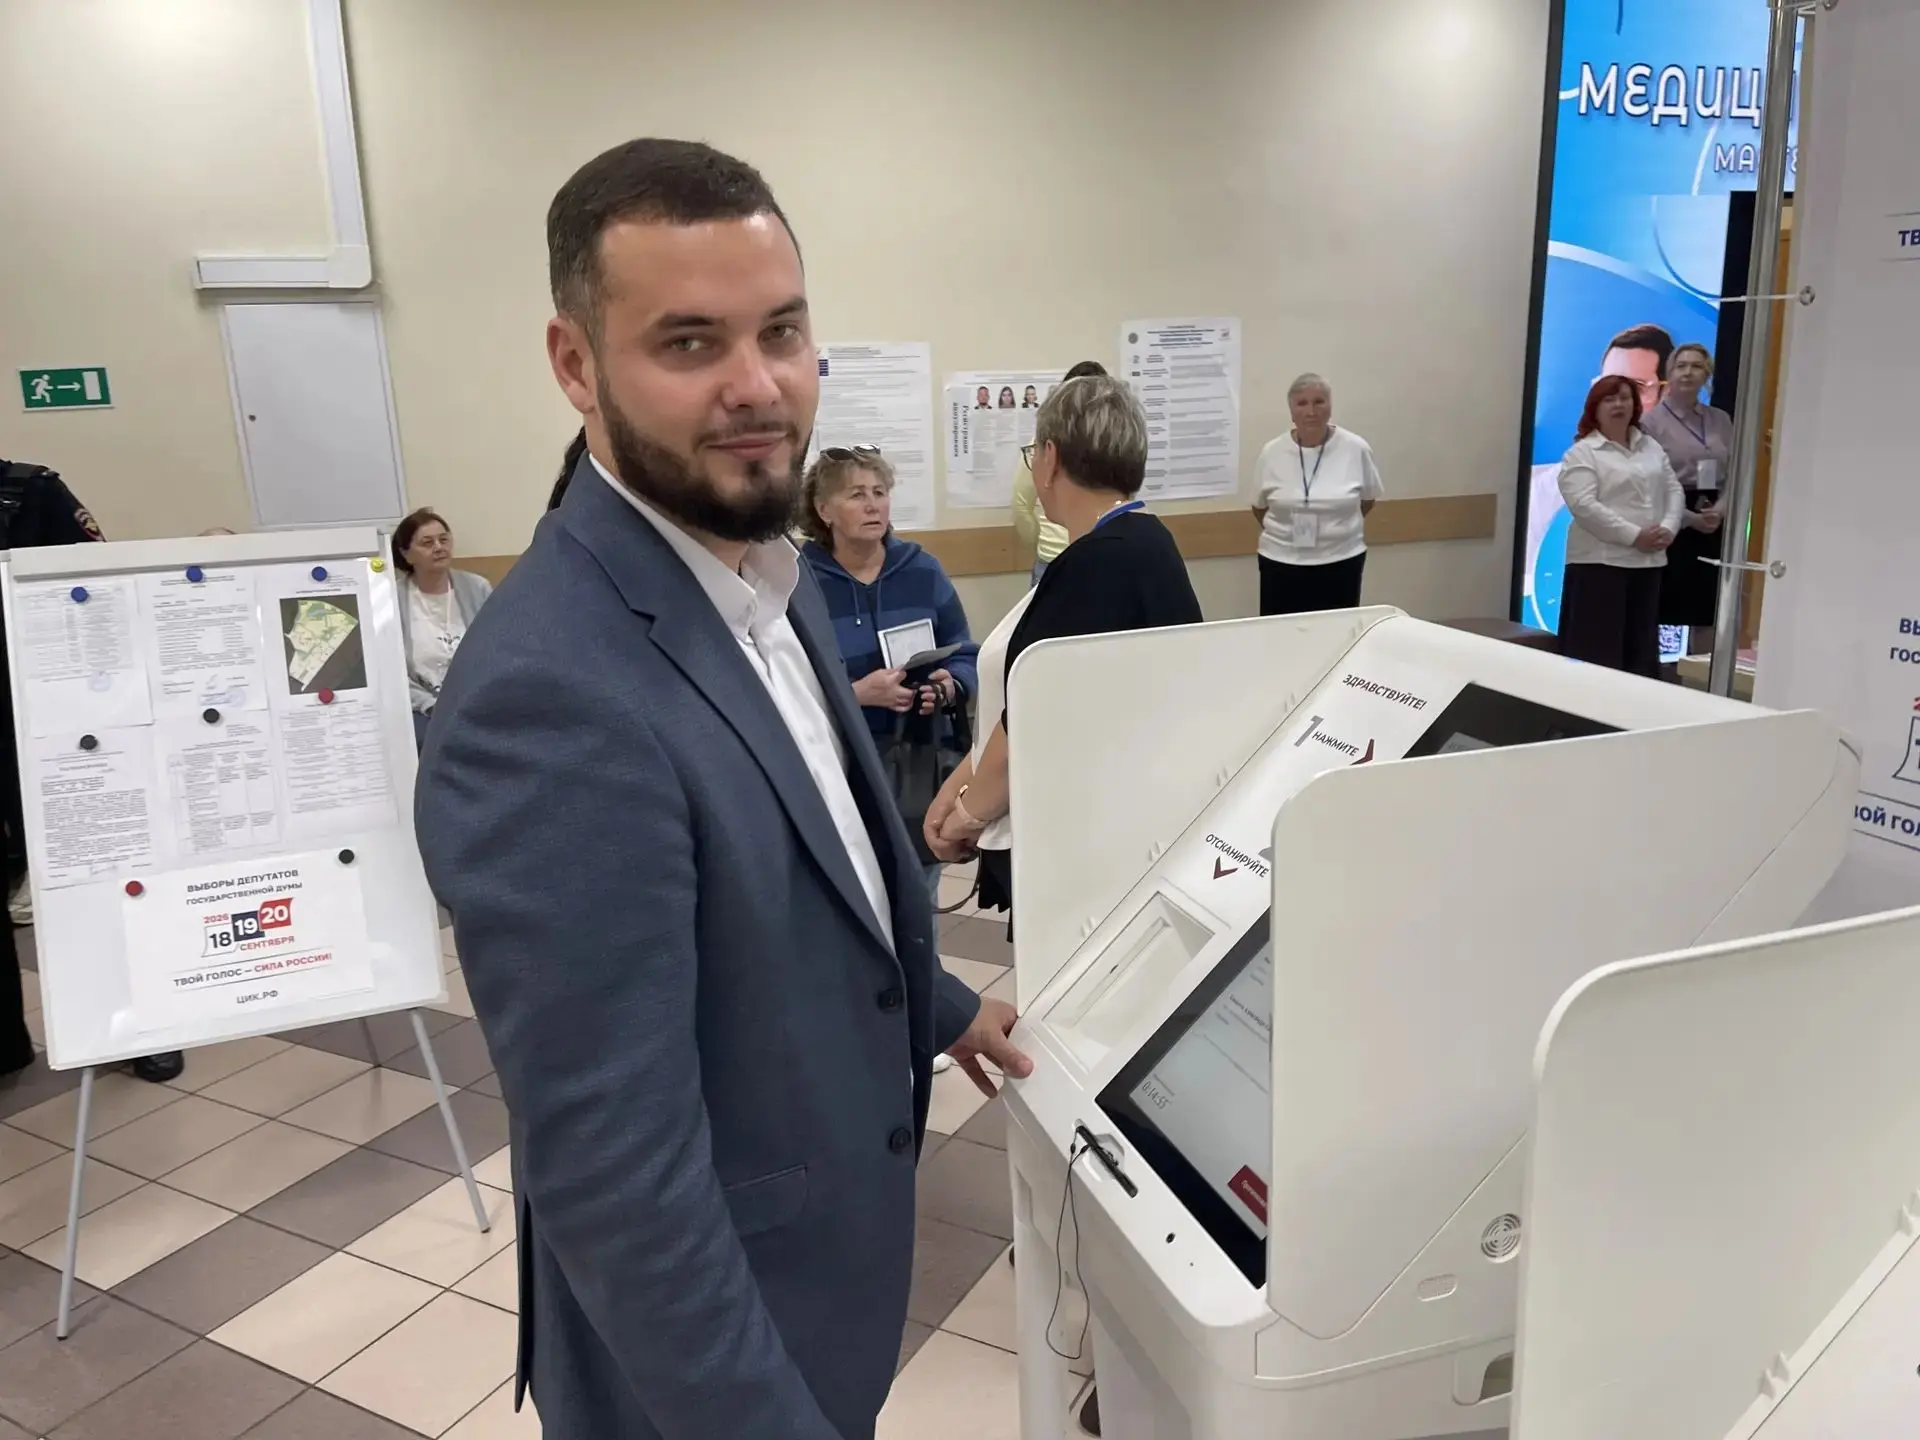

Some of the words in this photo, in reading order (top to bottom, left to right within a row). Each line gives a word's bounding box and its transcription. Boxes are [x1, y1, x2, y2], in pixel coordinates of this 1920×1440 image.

[1578, 63, 1796, 127] МЕДИЦ
[1342, 674, 1427, 711] ЗДРАВСТВУЙТЕ!
[1293, 715, 1324, 748] 1
[1312, 731, 1360, 757] НАЖМИТЕ
[1205, 834, 1270, 878] ОТСКАНИРУЙТЕ
[186, 886, 274, 905] ГОСУДАРСТВЕННОЙ
[275, 882, 302, 895] ДУМЫ
[187, 879, 234, 893] ВЫБОРЫ
[237, 869, 299, 887] ДЕПУТАТОВ
[203, 913, 230, 924] 2026
[209, 931, 232, 949] 18
[234, 917, 258, 936] 19
[261, 905, 289, 924] 20
[240, 936, 295, 951] СЕНТЯБРЯ
[174, 972, 204, 987] ТВОЙ
[206, 968, 242, 982] ГОЛОС
[254, 961, 283, 973] СИЛА
[286, 953, 332, 968] РОССИИ!
[236, 990, 279, 1004] ЦИК.РФ
